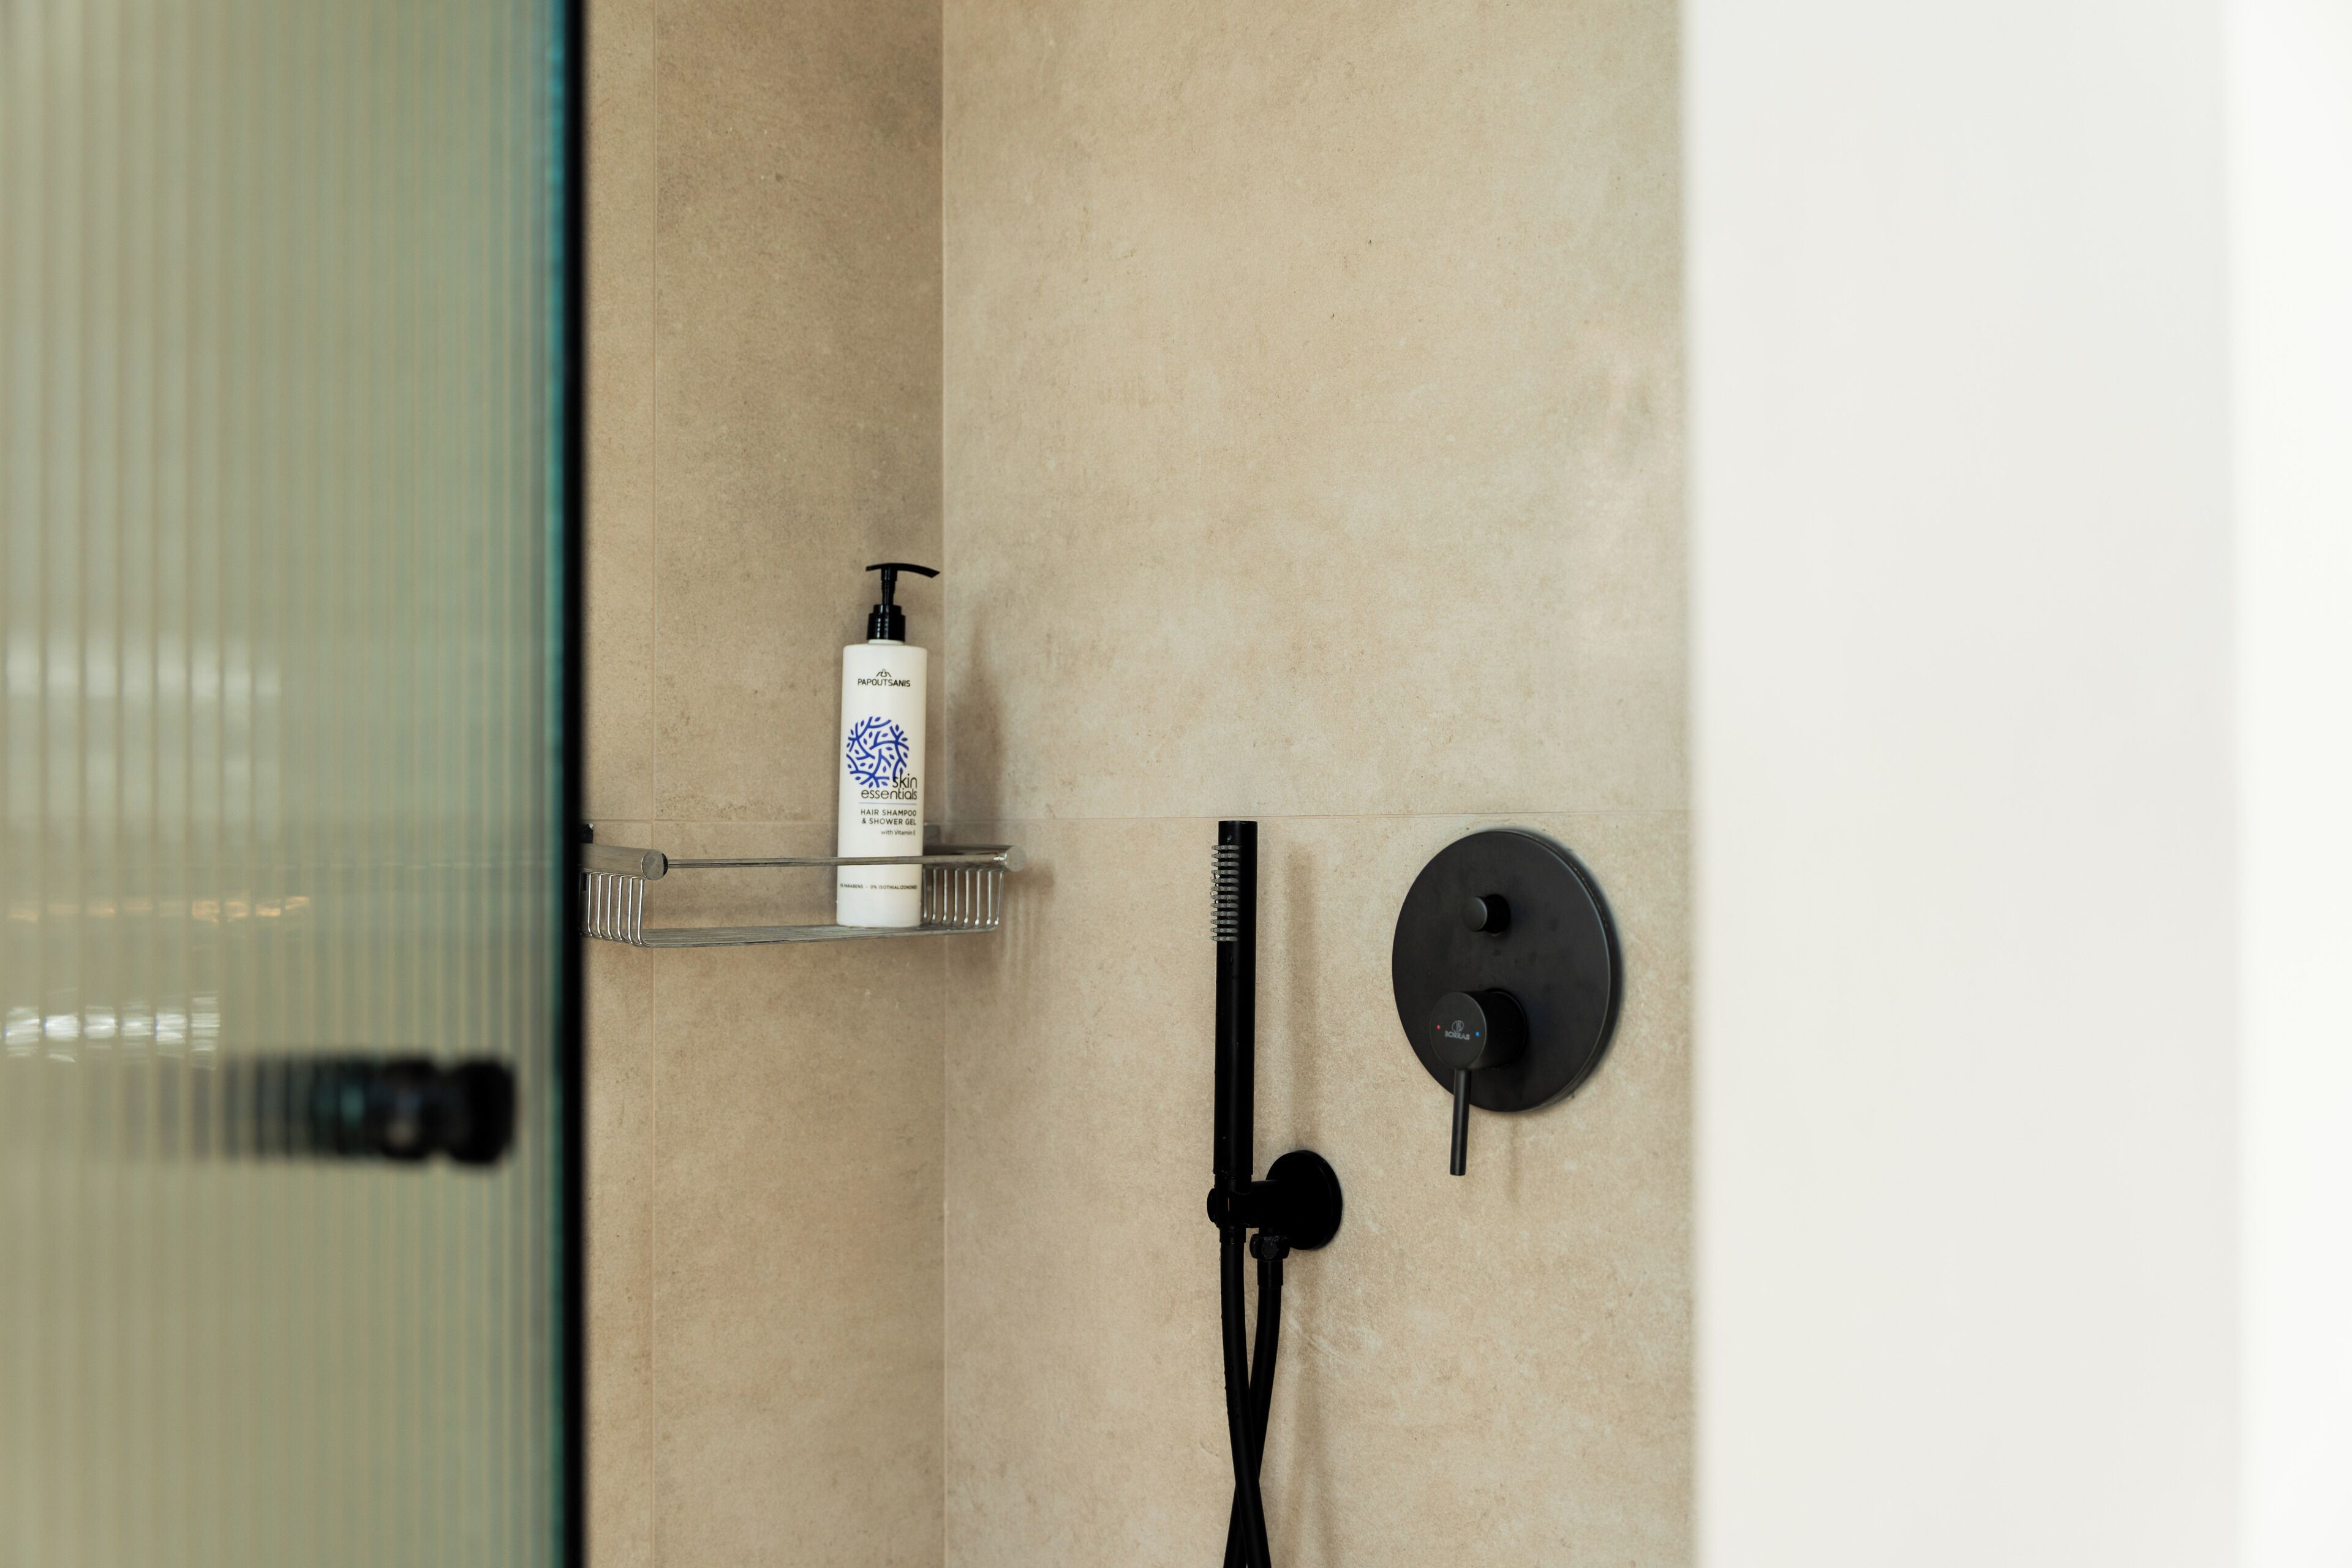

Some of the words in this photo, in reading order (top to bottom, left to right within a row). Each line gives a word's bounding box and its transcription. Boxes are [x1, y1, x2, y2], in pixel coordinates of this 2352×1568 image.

[858, 678, 911, 687] PAPOUTSANIS
[892, 773, 918, 788] skin
[861, 787, 918, 800] essentials
[1445, 1030, 1470, 1040] BORRAS
